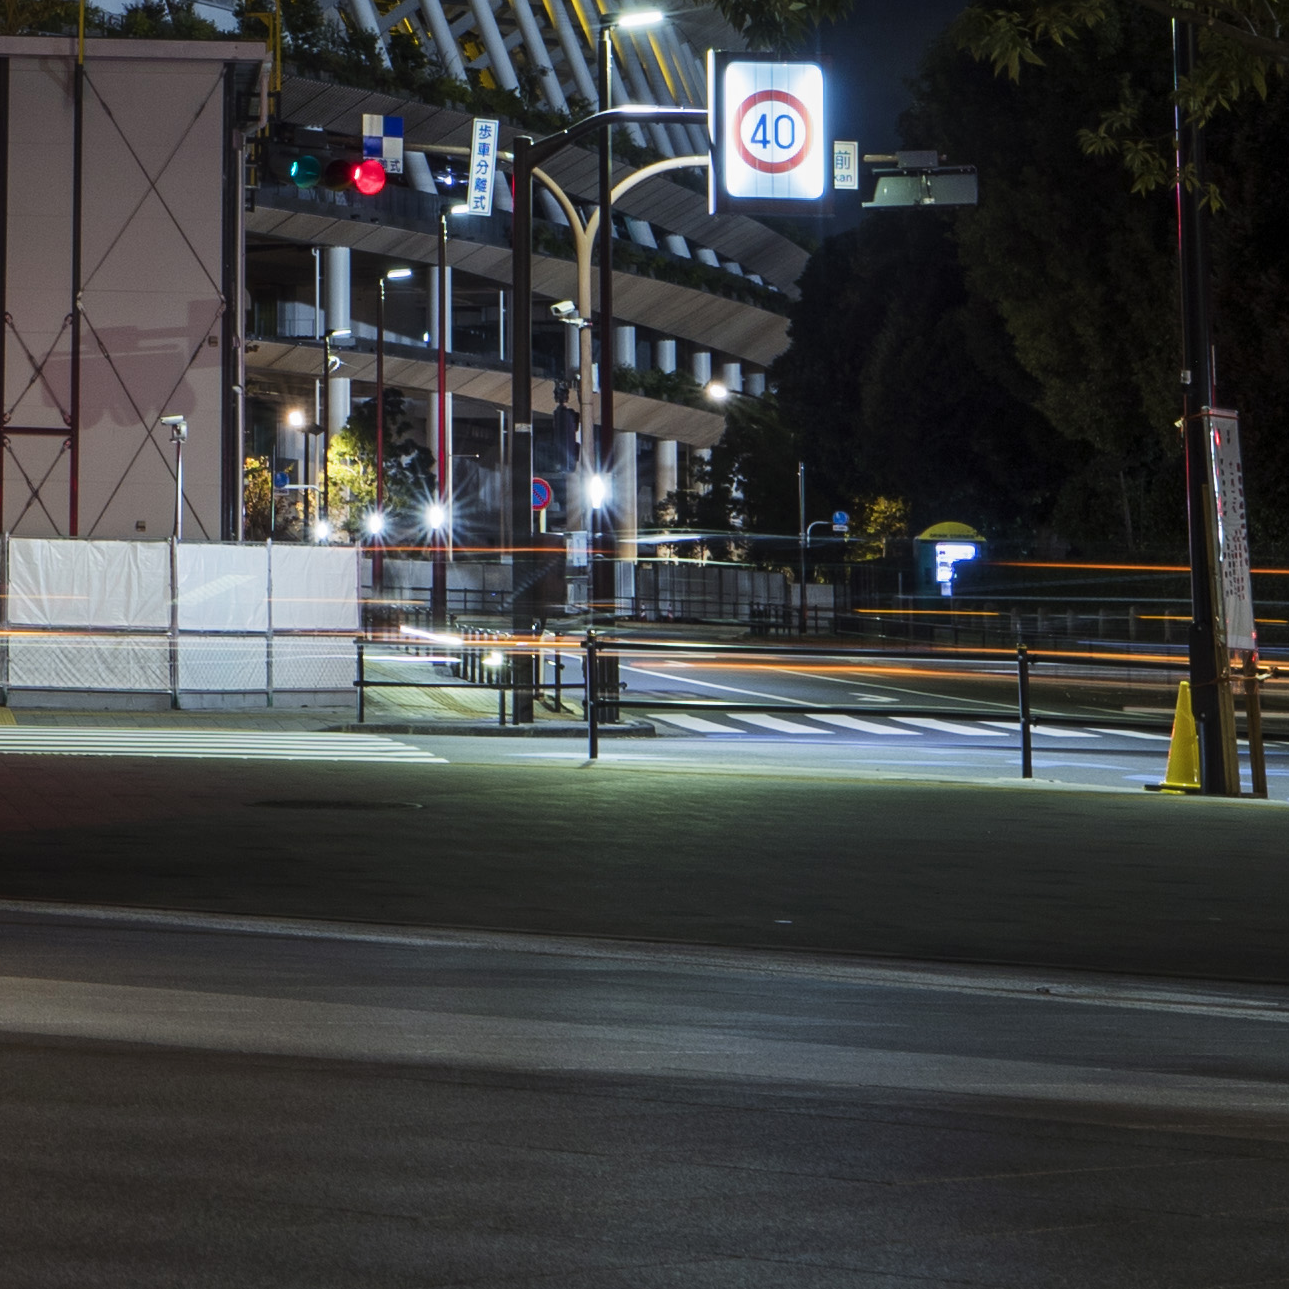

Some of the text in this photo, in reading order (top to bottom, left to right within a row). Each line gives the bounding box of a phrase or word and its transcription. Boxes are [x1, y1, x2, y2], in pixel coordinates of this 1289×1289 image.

[751, 113, 795, 149] 40
[473, 124, 492, 210] 歩車分離式
